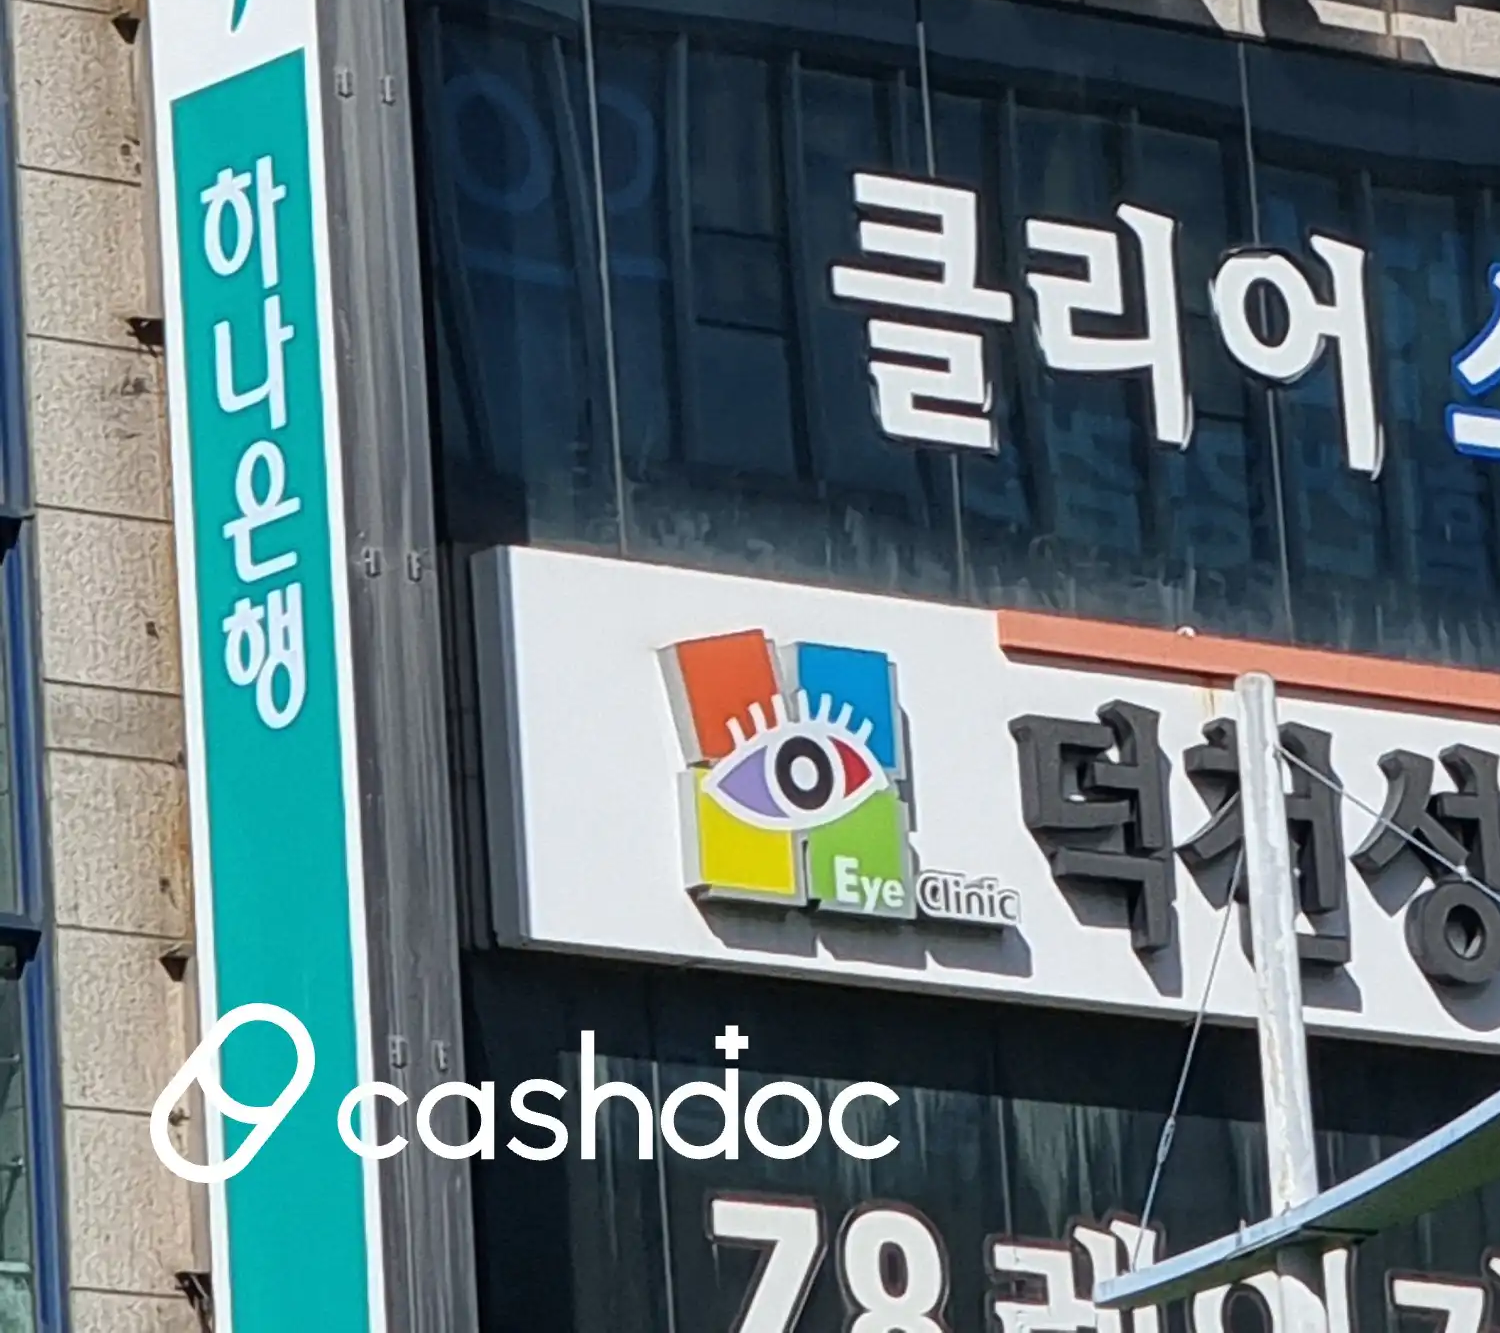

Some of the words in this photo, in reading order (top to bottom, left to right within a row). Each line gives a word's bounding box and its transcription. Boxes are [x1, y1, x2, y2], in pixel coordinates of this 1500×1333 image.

[830, 171, 1385, 481] 클리어
[200, 156, 307, 730] 하나은행
[834, 855, 905, 913] Eye
[917, 873, 1018, 921] Clinic
[710, 1197, 945, 1333] 78
